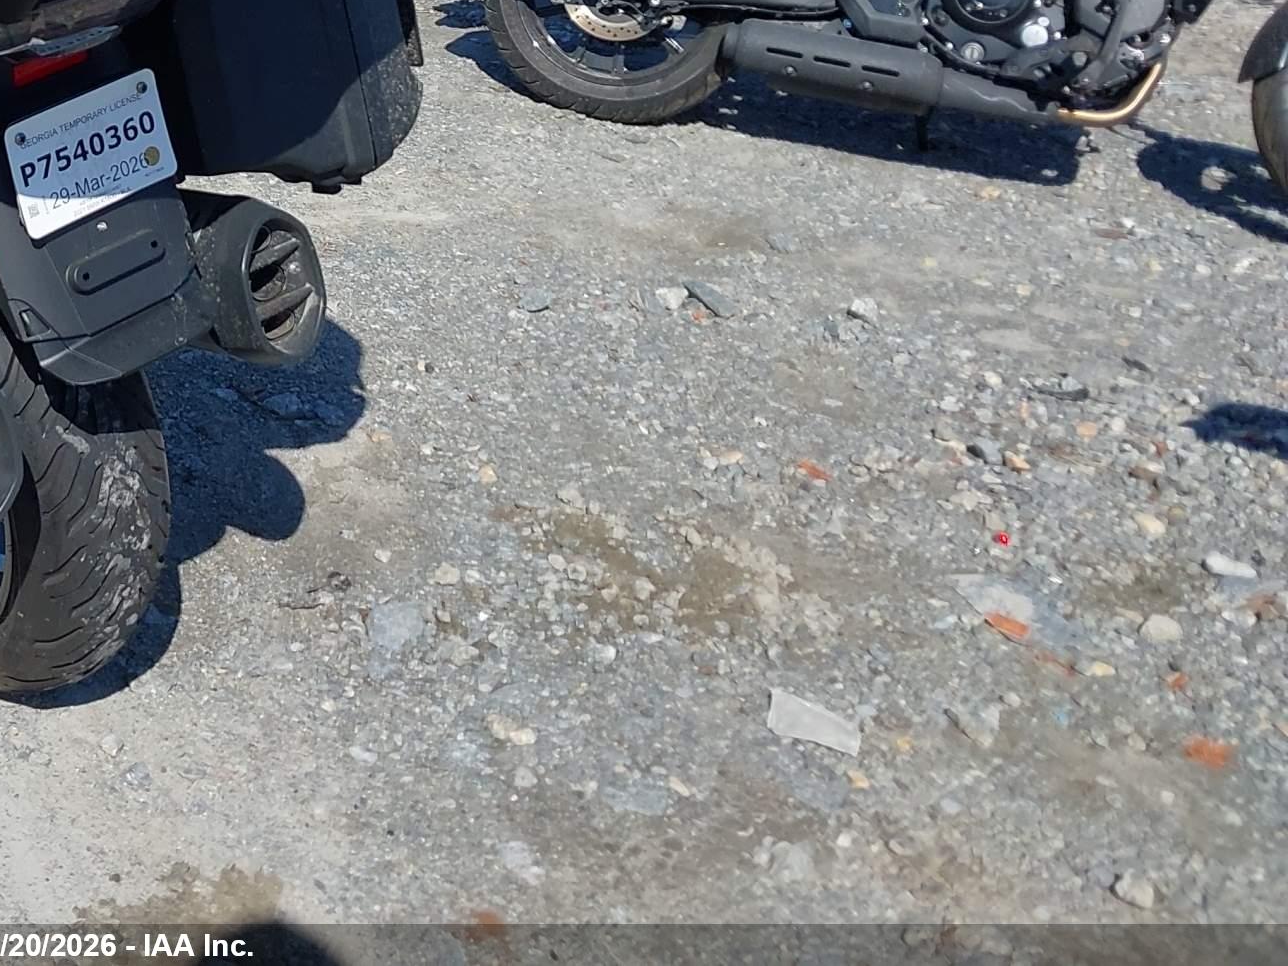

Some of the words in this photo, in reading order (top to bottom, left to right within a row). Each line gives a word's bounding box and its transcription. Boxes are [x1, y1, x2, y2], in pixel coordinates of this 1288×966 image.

[59, 105, 109, 132] TEMPORARY
[109, 92, 142, 112] LICENSE
[20, 110, 155, 187] P7540360
[50, 152, 149, 210] 29-Mar-2026
